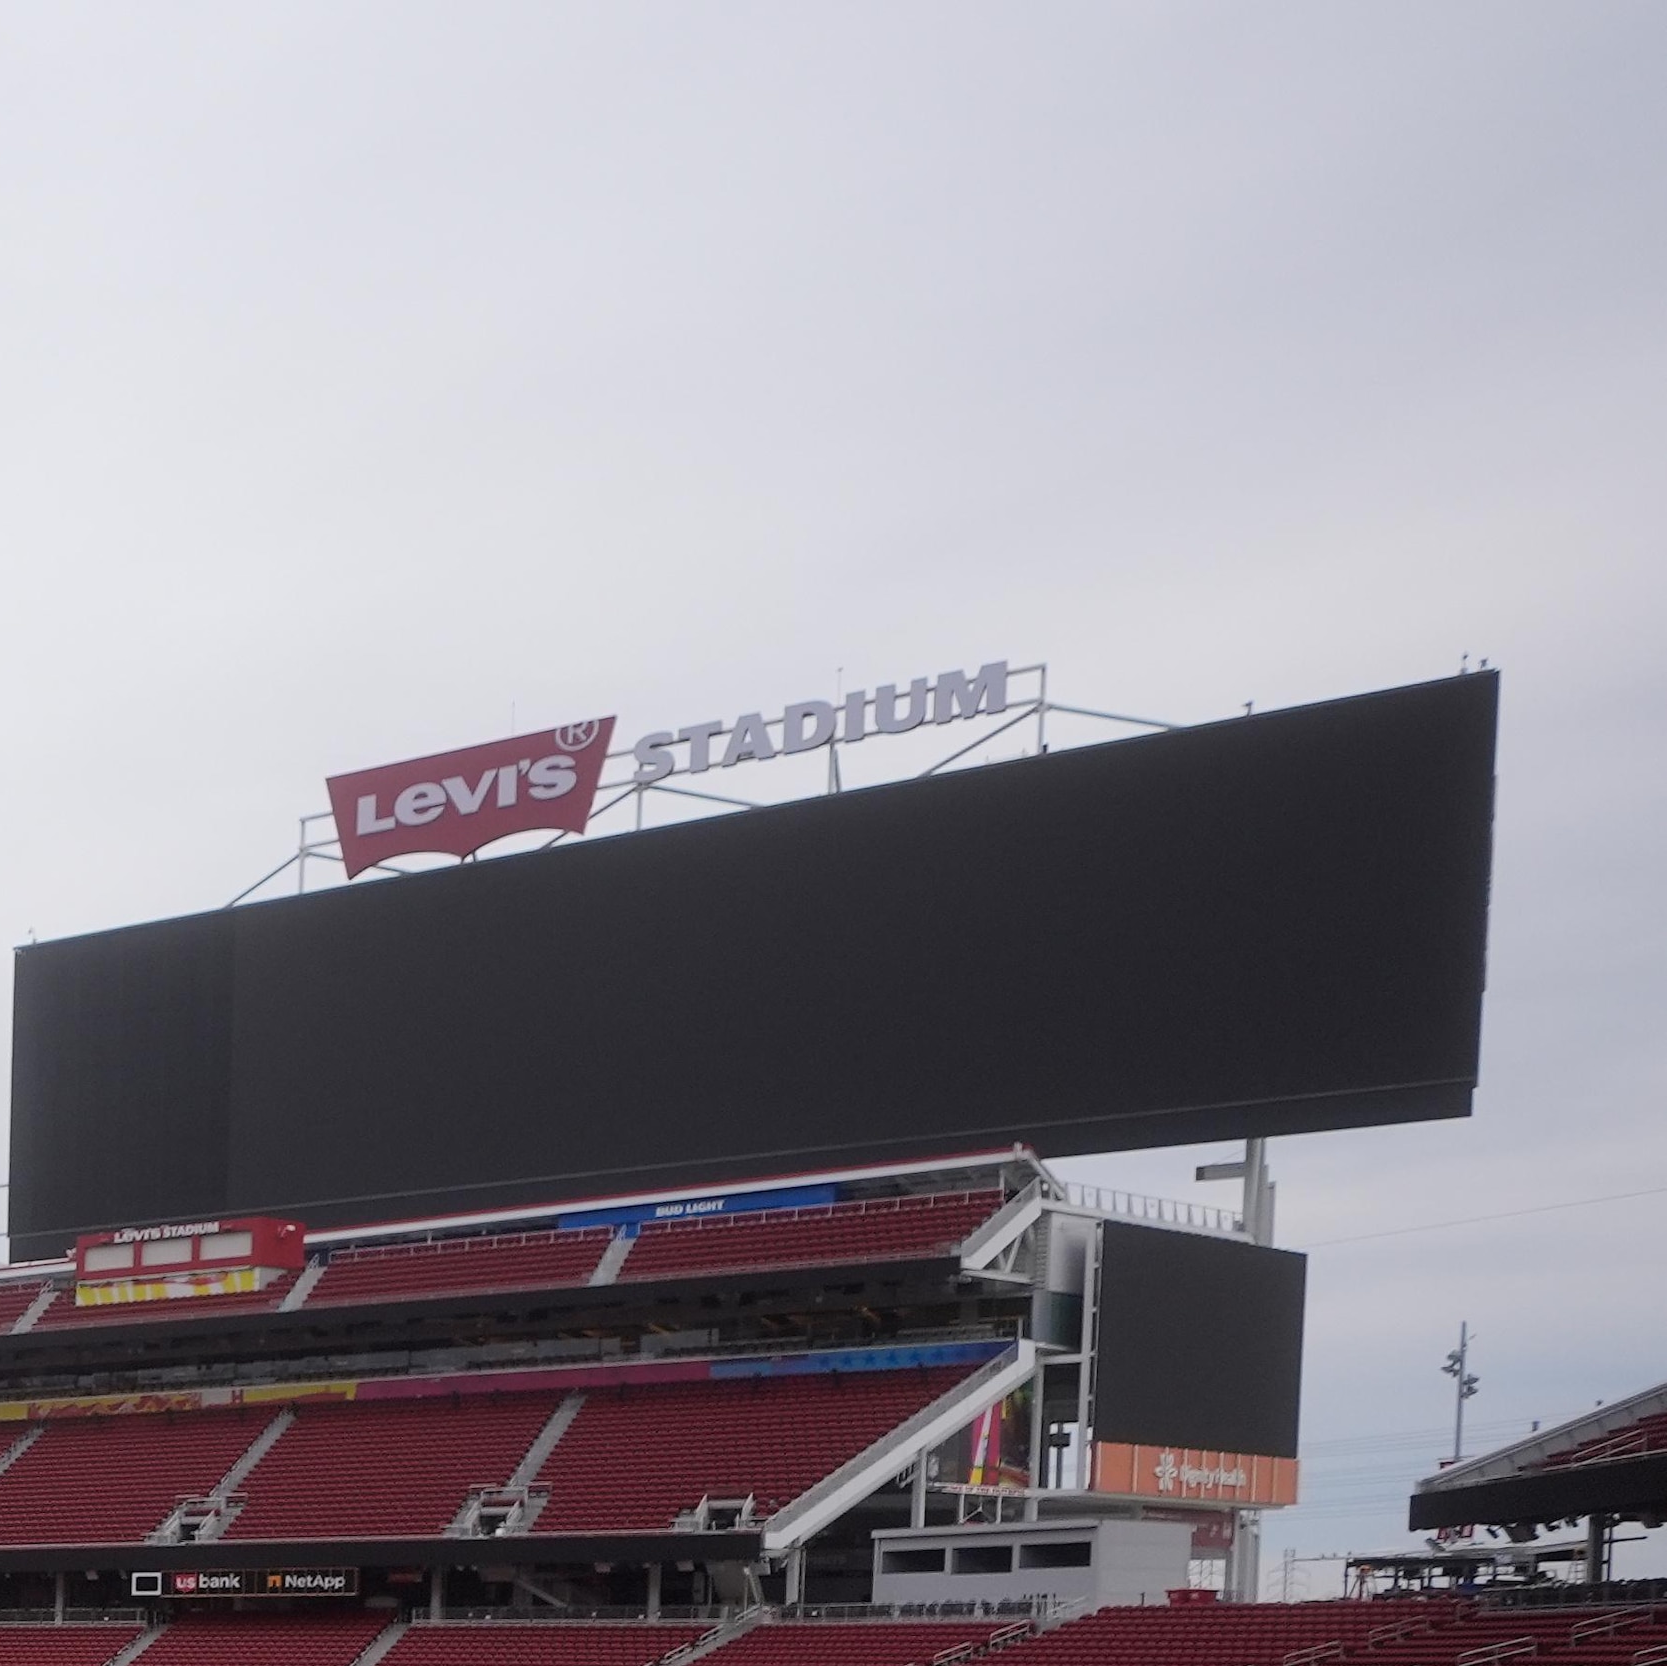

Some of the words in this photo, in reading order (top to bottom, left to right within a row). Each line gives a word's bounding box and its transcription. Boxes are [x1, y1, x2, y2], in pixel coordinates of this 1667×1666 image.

[632, 660, 1009, 784] STADIUM
[655, 1203, 683, 1218] BUD
[685, 1200, 725, 1216] LIGHT
[162, 1220, 220, 1239] STADIUM
[175, 1576, 197, 1589] us
[198, 1573, 241, 1589] bank
[284, 1574, 346, 1590] NetApp
